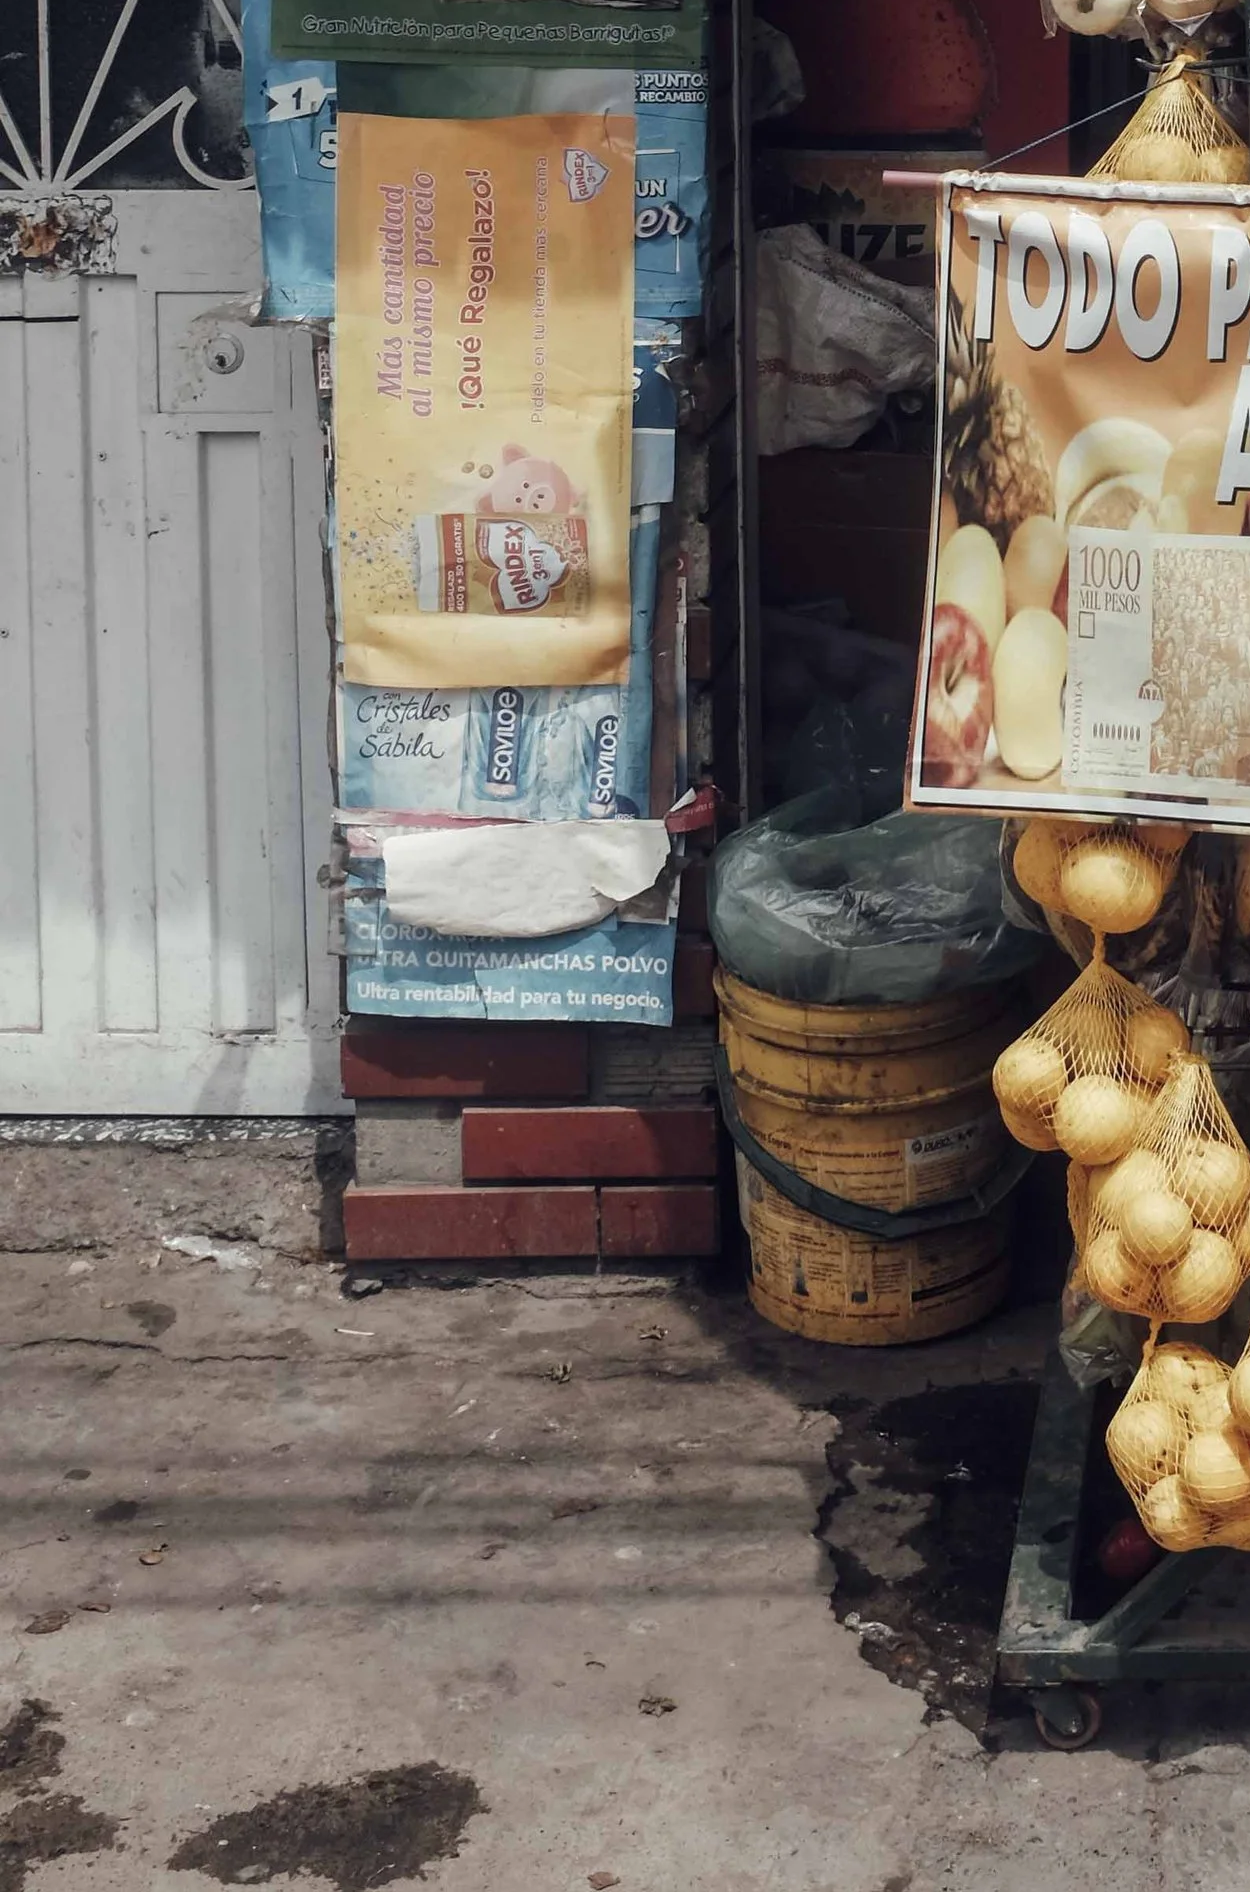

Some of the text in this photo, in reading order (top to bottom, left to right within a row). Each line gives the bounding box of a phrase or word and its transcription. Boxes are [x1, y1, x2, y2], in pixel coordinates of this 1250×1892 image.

[301, 14, 348, 37] Gran
[431, 22, 475, 42] para
[639, 90, 706, 104] RECAMBIO
[574, 150, 590, 198] RINDEX
[377, 183, 406, 401] Más cantidad
[407, 169, 441, 418] al mismo precio
[456, 168, 495, 410] ¡Qué Regalazo!
[967, 208, 1182, 362] TODO
[504, 524, 539, 606] RINDEX
[1079, 544, 1142, 593] 1000
[1078, 588, 1141, 615] MIL PESOS
[356, 691, 451, 724] Cristales
[383, 691, 401, 702] con
[359, 733, 445, 760] Sábila
[425, 949, 596, 972] QUITAMANCHAS
[601, 955, 669, 976] POLVO
[356, 981, 666, 1012] Ultra rentabilidad para tu negocio.
